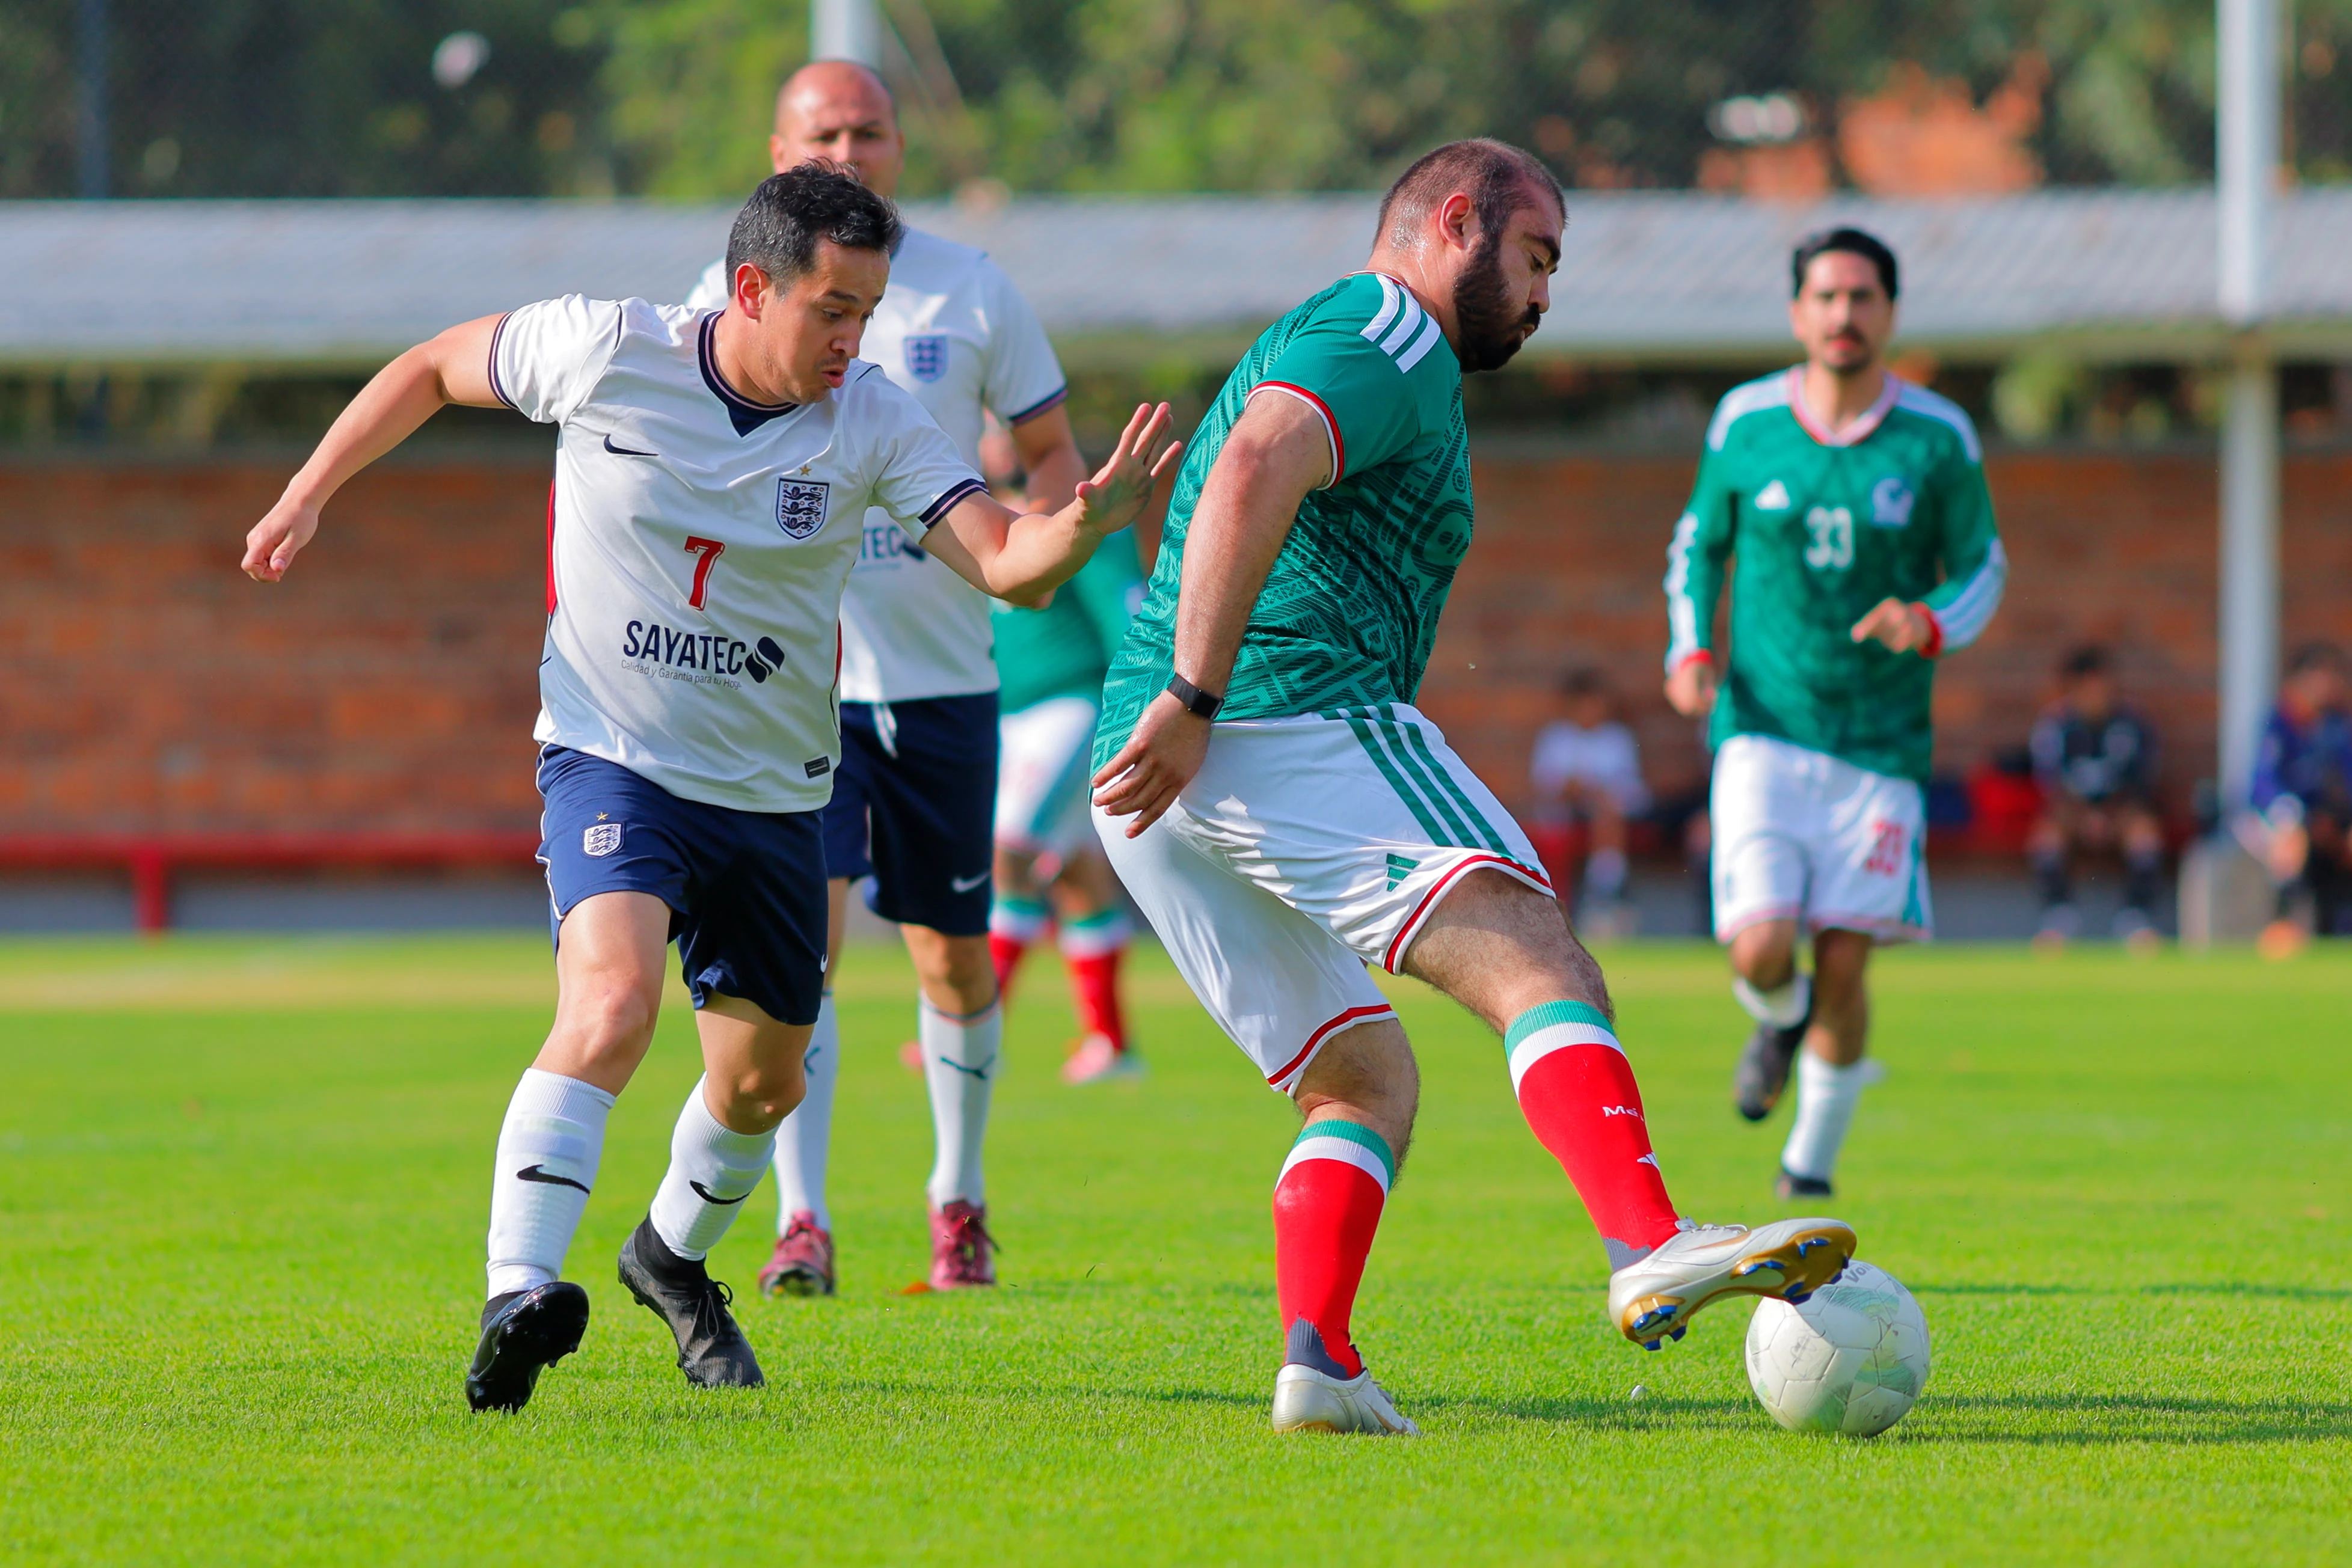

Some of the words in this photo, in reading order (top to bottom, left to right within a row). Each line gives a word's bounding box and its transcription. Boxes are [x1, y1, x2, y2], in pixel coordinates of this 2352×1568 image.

[1806, 506, 1853, 568] 33
[684, 536, 725, 611] 7
[621, 660, 649, 675] Calidad
[651, 669, 657, 678] y
[659, 668, 692, 682] Garantía
[695, 675, 712, 684] para
[624, 620, 746, 675] SAYATEC
